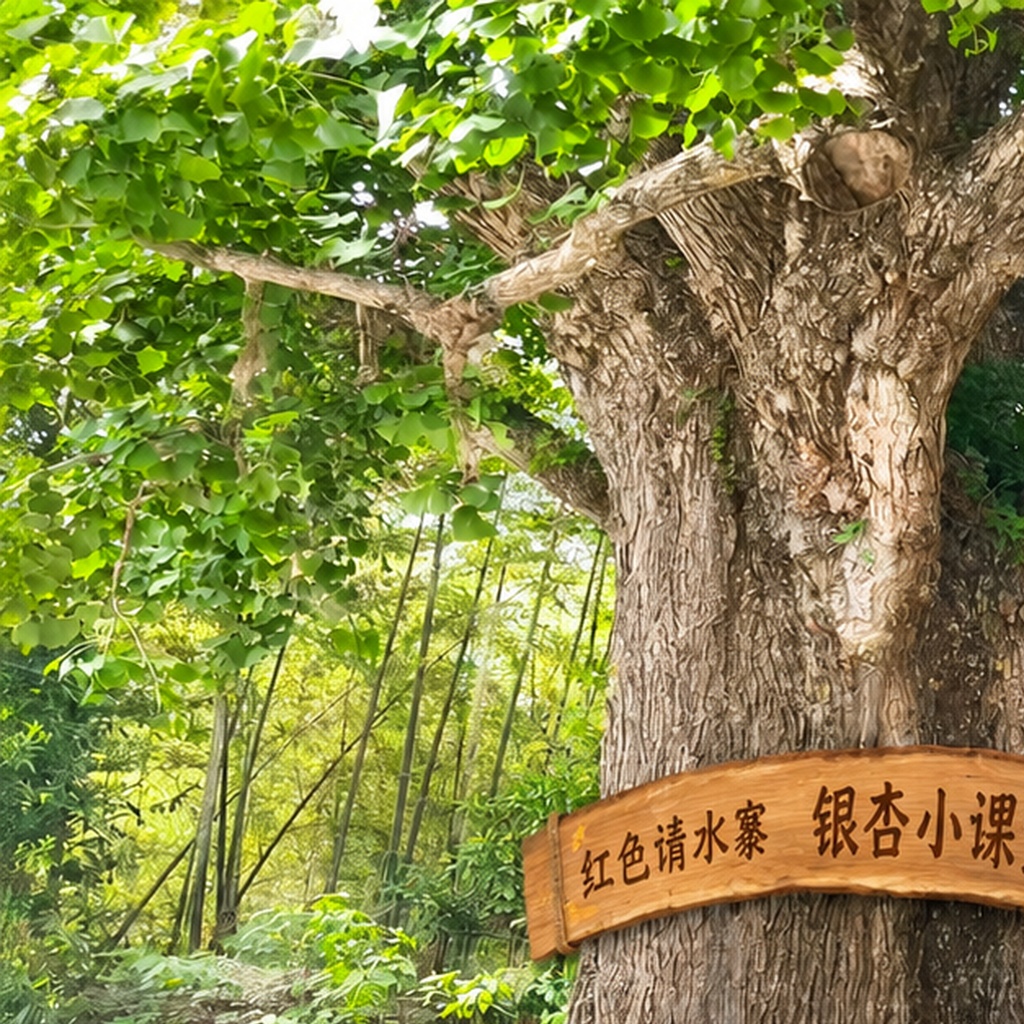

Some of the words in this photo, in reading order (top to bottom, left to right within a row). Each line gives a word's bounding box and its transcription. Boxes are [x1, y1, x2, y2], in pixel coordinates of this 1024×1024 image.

[581, 799, 769, 899] 红色请水寨
